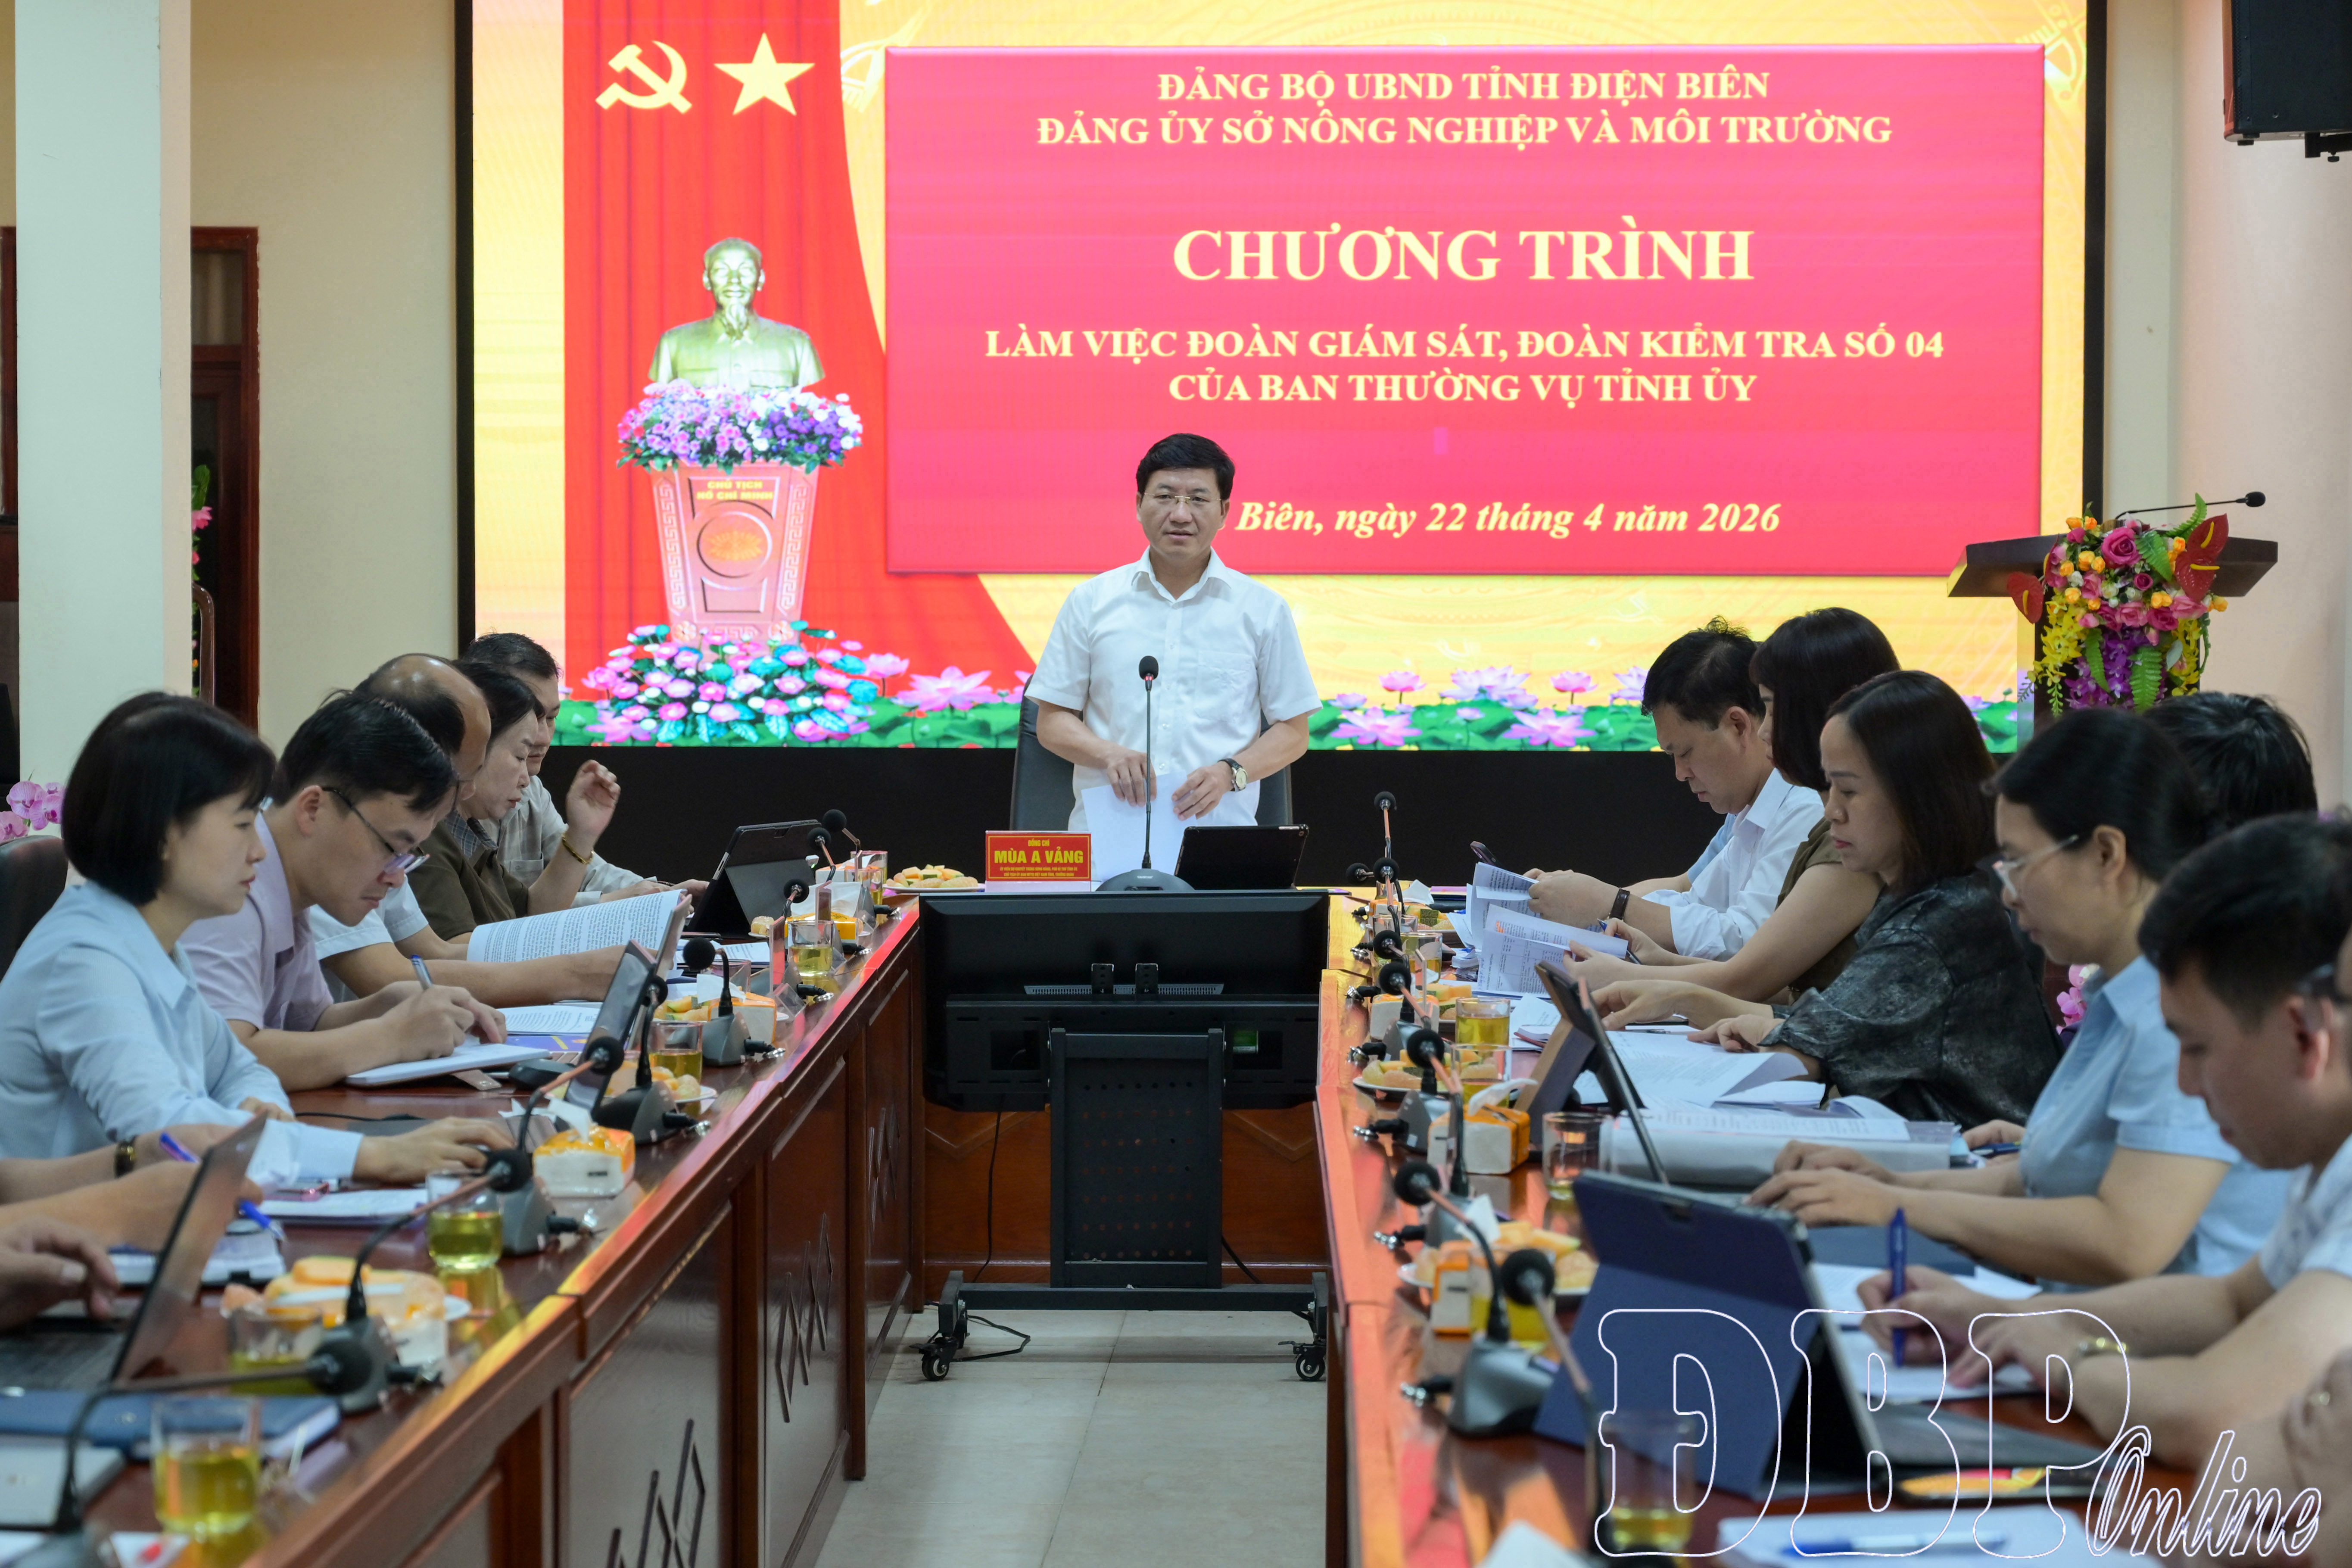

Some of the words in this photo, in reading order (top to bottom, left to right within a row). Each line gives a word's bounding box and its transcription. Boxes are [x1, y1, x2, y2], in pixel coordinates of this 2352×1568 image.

[1158, 66, 1270, 100] ĐẢNG
[1280, 70, 1335, 107] BỘ
[1345, 73, 1452, 100] UBND
[1462, 65, 1560, 100] TỈNH
[1570, 69, 1666, 106] ĐIỆN
[1676, 64, 1770, 99] BIÊN
[1037, 110, 1149, 144] ĐẢNG
[1159, 110, 1214, 143] ỦY
[1222, 110, 1274, 143] SỞ
[1282, 108, 1397, 143] NÔNG
[1407, 114, 1558, 151] NGHIỆP
[1565, 109, 1620, 143] VÀ
[1630, 108, 1711, 143] MÔI
[1720, 109, 1892, 143] TRƯỜNG
[1174, 222, 1501, 281] CHƯƠNG
[1519, 215, 1754, 280] TRÌNH
[985, 323, 1073, 357] LÀM
[1082, 327, 1177, 365] VIỆC
[1187, 323, 1299, 357] ĐOÀN
[1309, 323, 1417, 357] GIÁM
[1427, 323, 1508, 362] SÁT,
[1517, 323, 1629, 357] ĐOÀN
[1640, 322, 1746, 357] KIỂM
[1756, 331, 1837, 358] TRA
[1906, 331, 1944, 358] 04
[1169, 367, 1252, 400] CỦA
[1259, 375, 1339, 401] BAN
[1348, 367, 1520, 401] THƯỜNG
[1530, 375, 1585, 408] VỤ
[1594, 367, 1692, 401] TỈNH
[1702, 367, 1757, 401] ỦY
[1235, 501, 1323, 535] Biên,
[1335, 502, 1417, 538] ngày
[1425, 503, 1467, 530] 22
[1476, 502, 1574, 539] tháng
[1583, 503, 1604, 531] 4
[1614, 505, 1688, 531] năm
[1698, 503, 1781, 531] 2026
[994, 848, 1027, 863] MÙA
[1031, 851, 1041, 863] A
[1045, 846, 1084, 863] VẢNG
